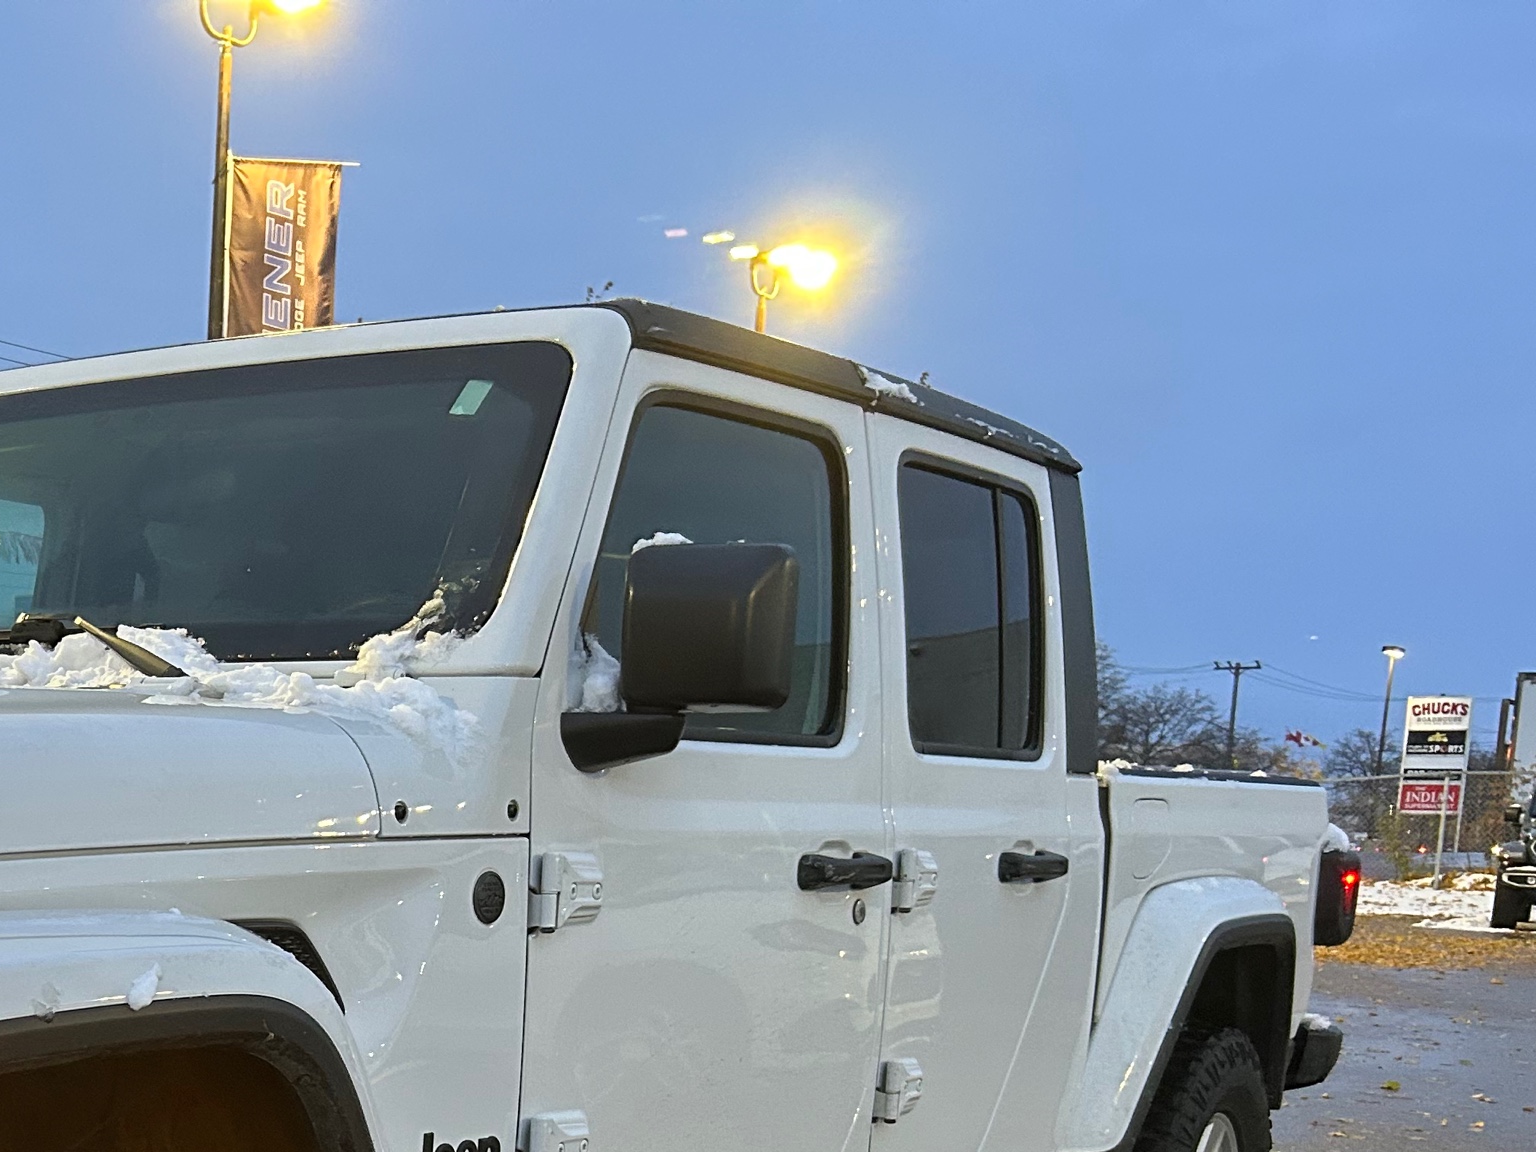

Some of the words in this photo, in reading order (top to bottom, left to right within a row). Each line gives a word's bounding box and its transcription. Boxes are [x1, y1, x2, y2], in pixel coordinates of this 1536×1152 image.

[297, 190, 307, 227] RAM
[262, 179, 295, 333] ENER
[294, 240, 306, 286] JEEP
[1411, 702, 1470, 716] CHUCK'S
